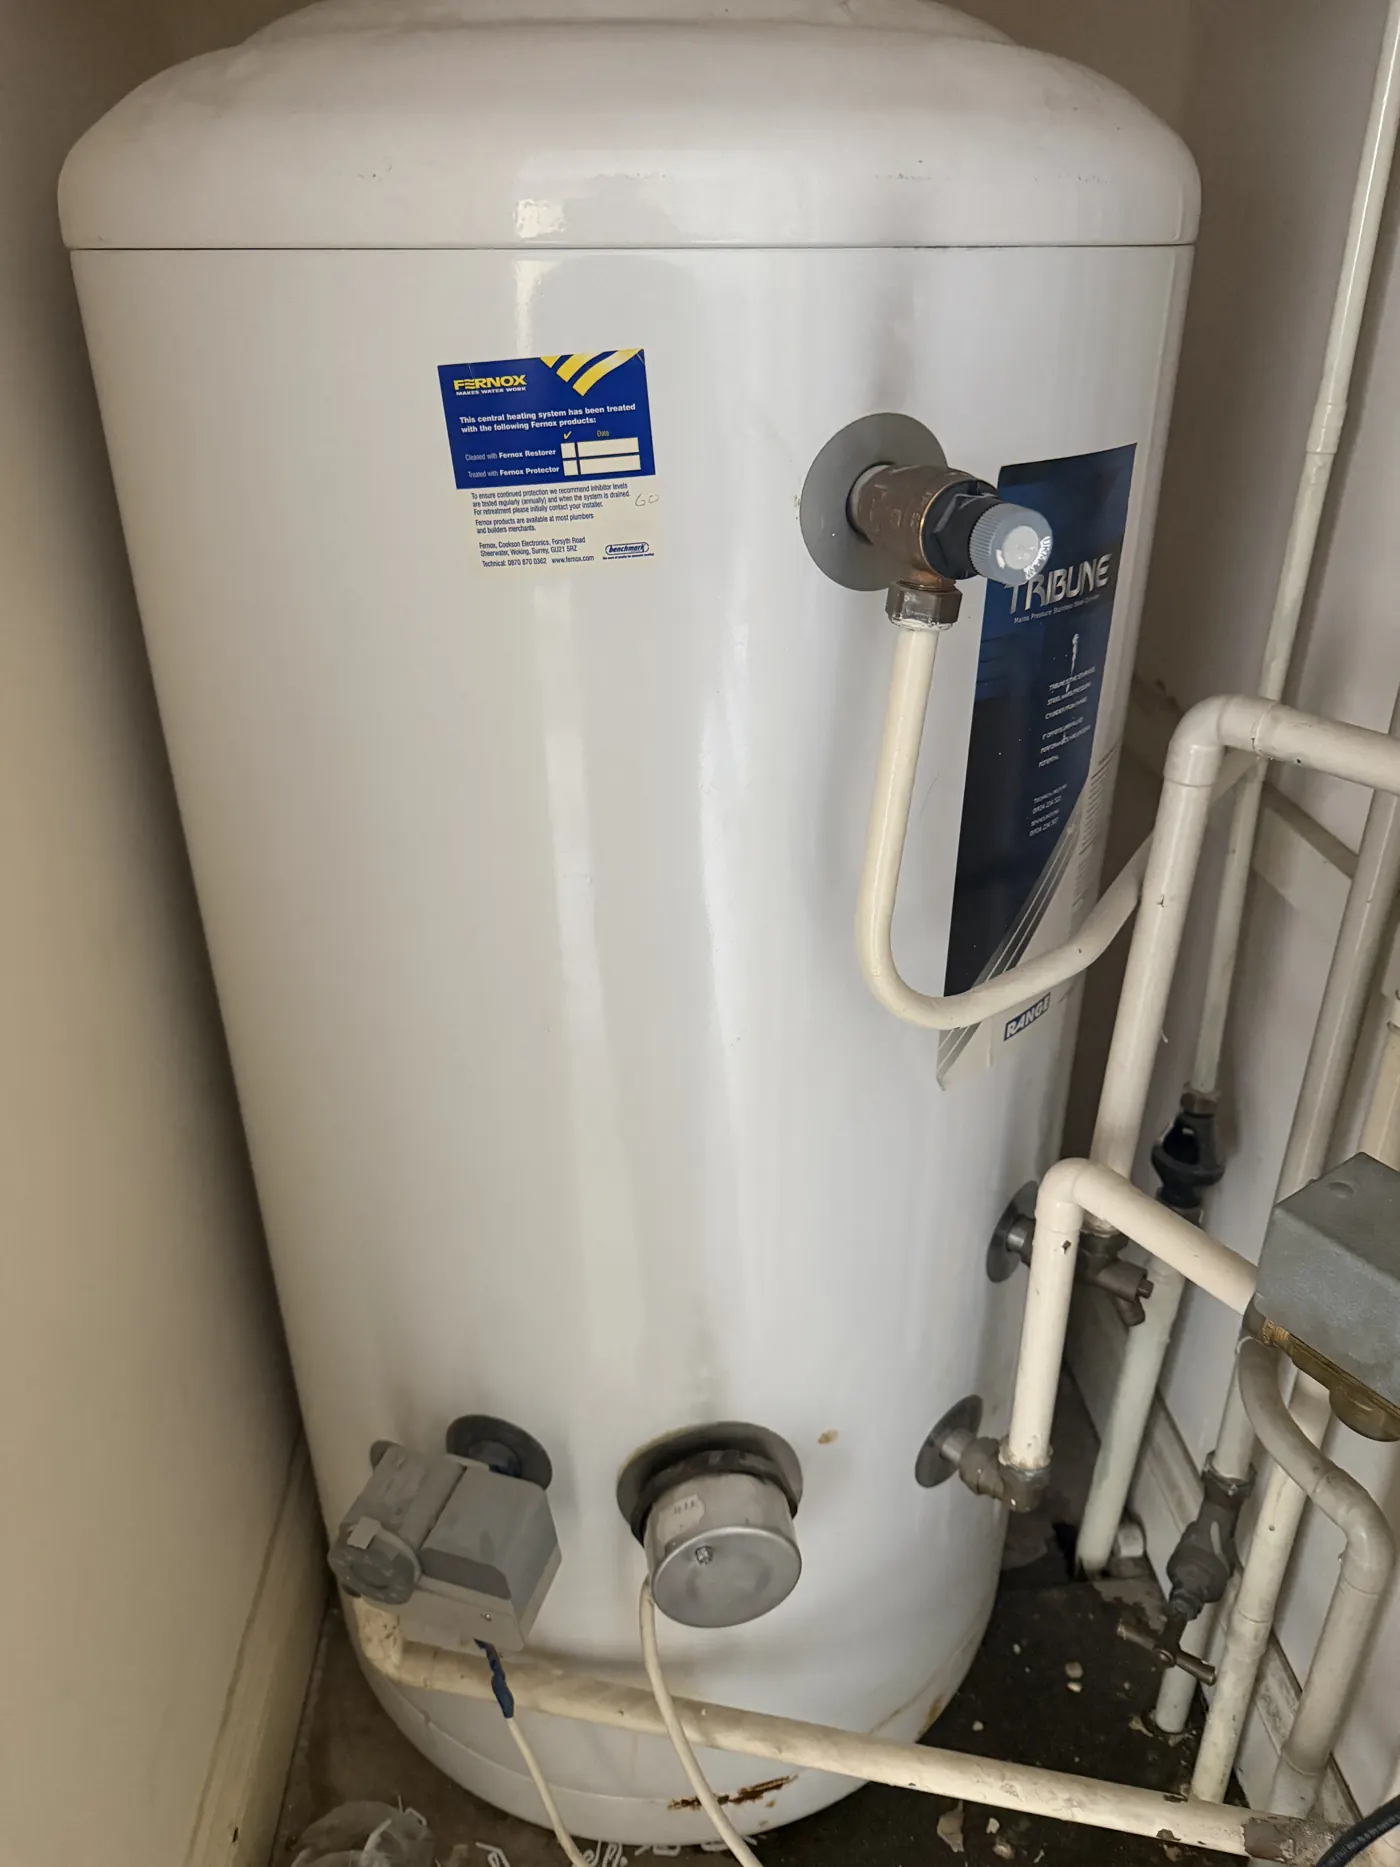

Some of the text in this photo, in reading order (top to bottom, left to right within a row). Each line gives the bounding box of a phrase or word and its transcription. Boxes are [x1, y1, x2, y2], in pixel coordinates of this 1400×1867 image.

[454, 375, 527, 390] FERNOX
[459, 416, 476, 424] This
[477, 414, 505, 422] central
[506, 412, 536, 421] heating
[538, 410, 566, 420] system
[585, 406, 605, 414] been
[606, 403, 636, 413] treated
[494, 422, 529, 431] following
[531, 420, 558, 428] Fernox
[559, 417, 597, 427] products:
[465, 449, 556, 461] Cleaned with Fernox Restorer
[467, 470, 486, 478] Treated
[499, 468, 523, 476] Fernox
[525, 466, 559, 475] Protector
[471, 492, 478, 500] To
[497, 491, 521, 499] continued
[523, 489, 549, 497] protection
[559, 485, 589, 494] recommend
[590, 483, 612, 492] inhibitor
[612, 482, 628, 490] levels
[498, 498, 520, 507] regularly
[521, 497, 547, 505] (annually)
[558, 494, 573, 502] when
[583, 493, 602, 501] system
[483, 507, 511, 515] retreatment
[512, 506, 529, 514] please
[569, 502, 581, 511] your
[493, 518, 516, 526] products
[555, 514, 569, 522] most
[570, 513, 594, 522] plumbers
[487, 526, 507, 534] builders
[552, 537, 571, 546] Forsyth
[571, 536, 586, 544] Road
[608, 543, 645, 553] benchmark
[482, 560, 506, 568] Technical:
[551, 555, 595, 563] www.fernox.com
[1004, 553, 1113, 615] TRIBUNE
[1013, 615, 1030, 624] Mains
[1031, 609, 1052, 619] Pressure
